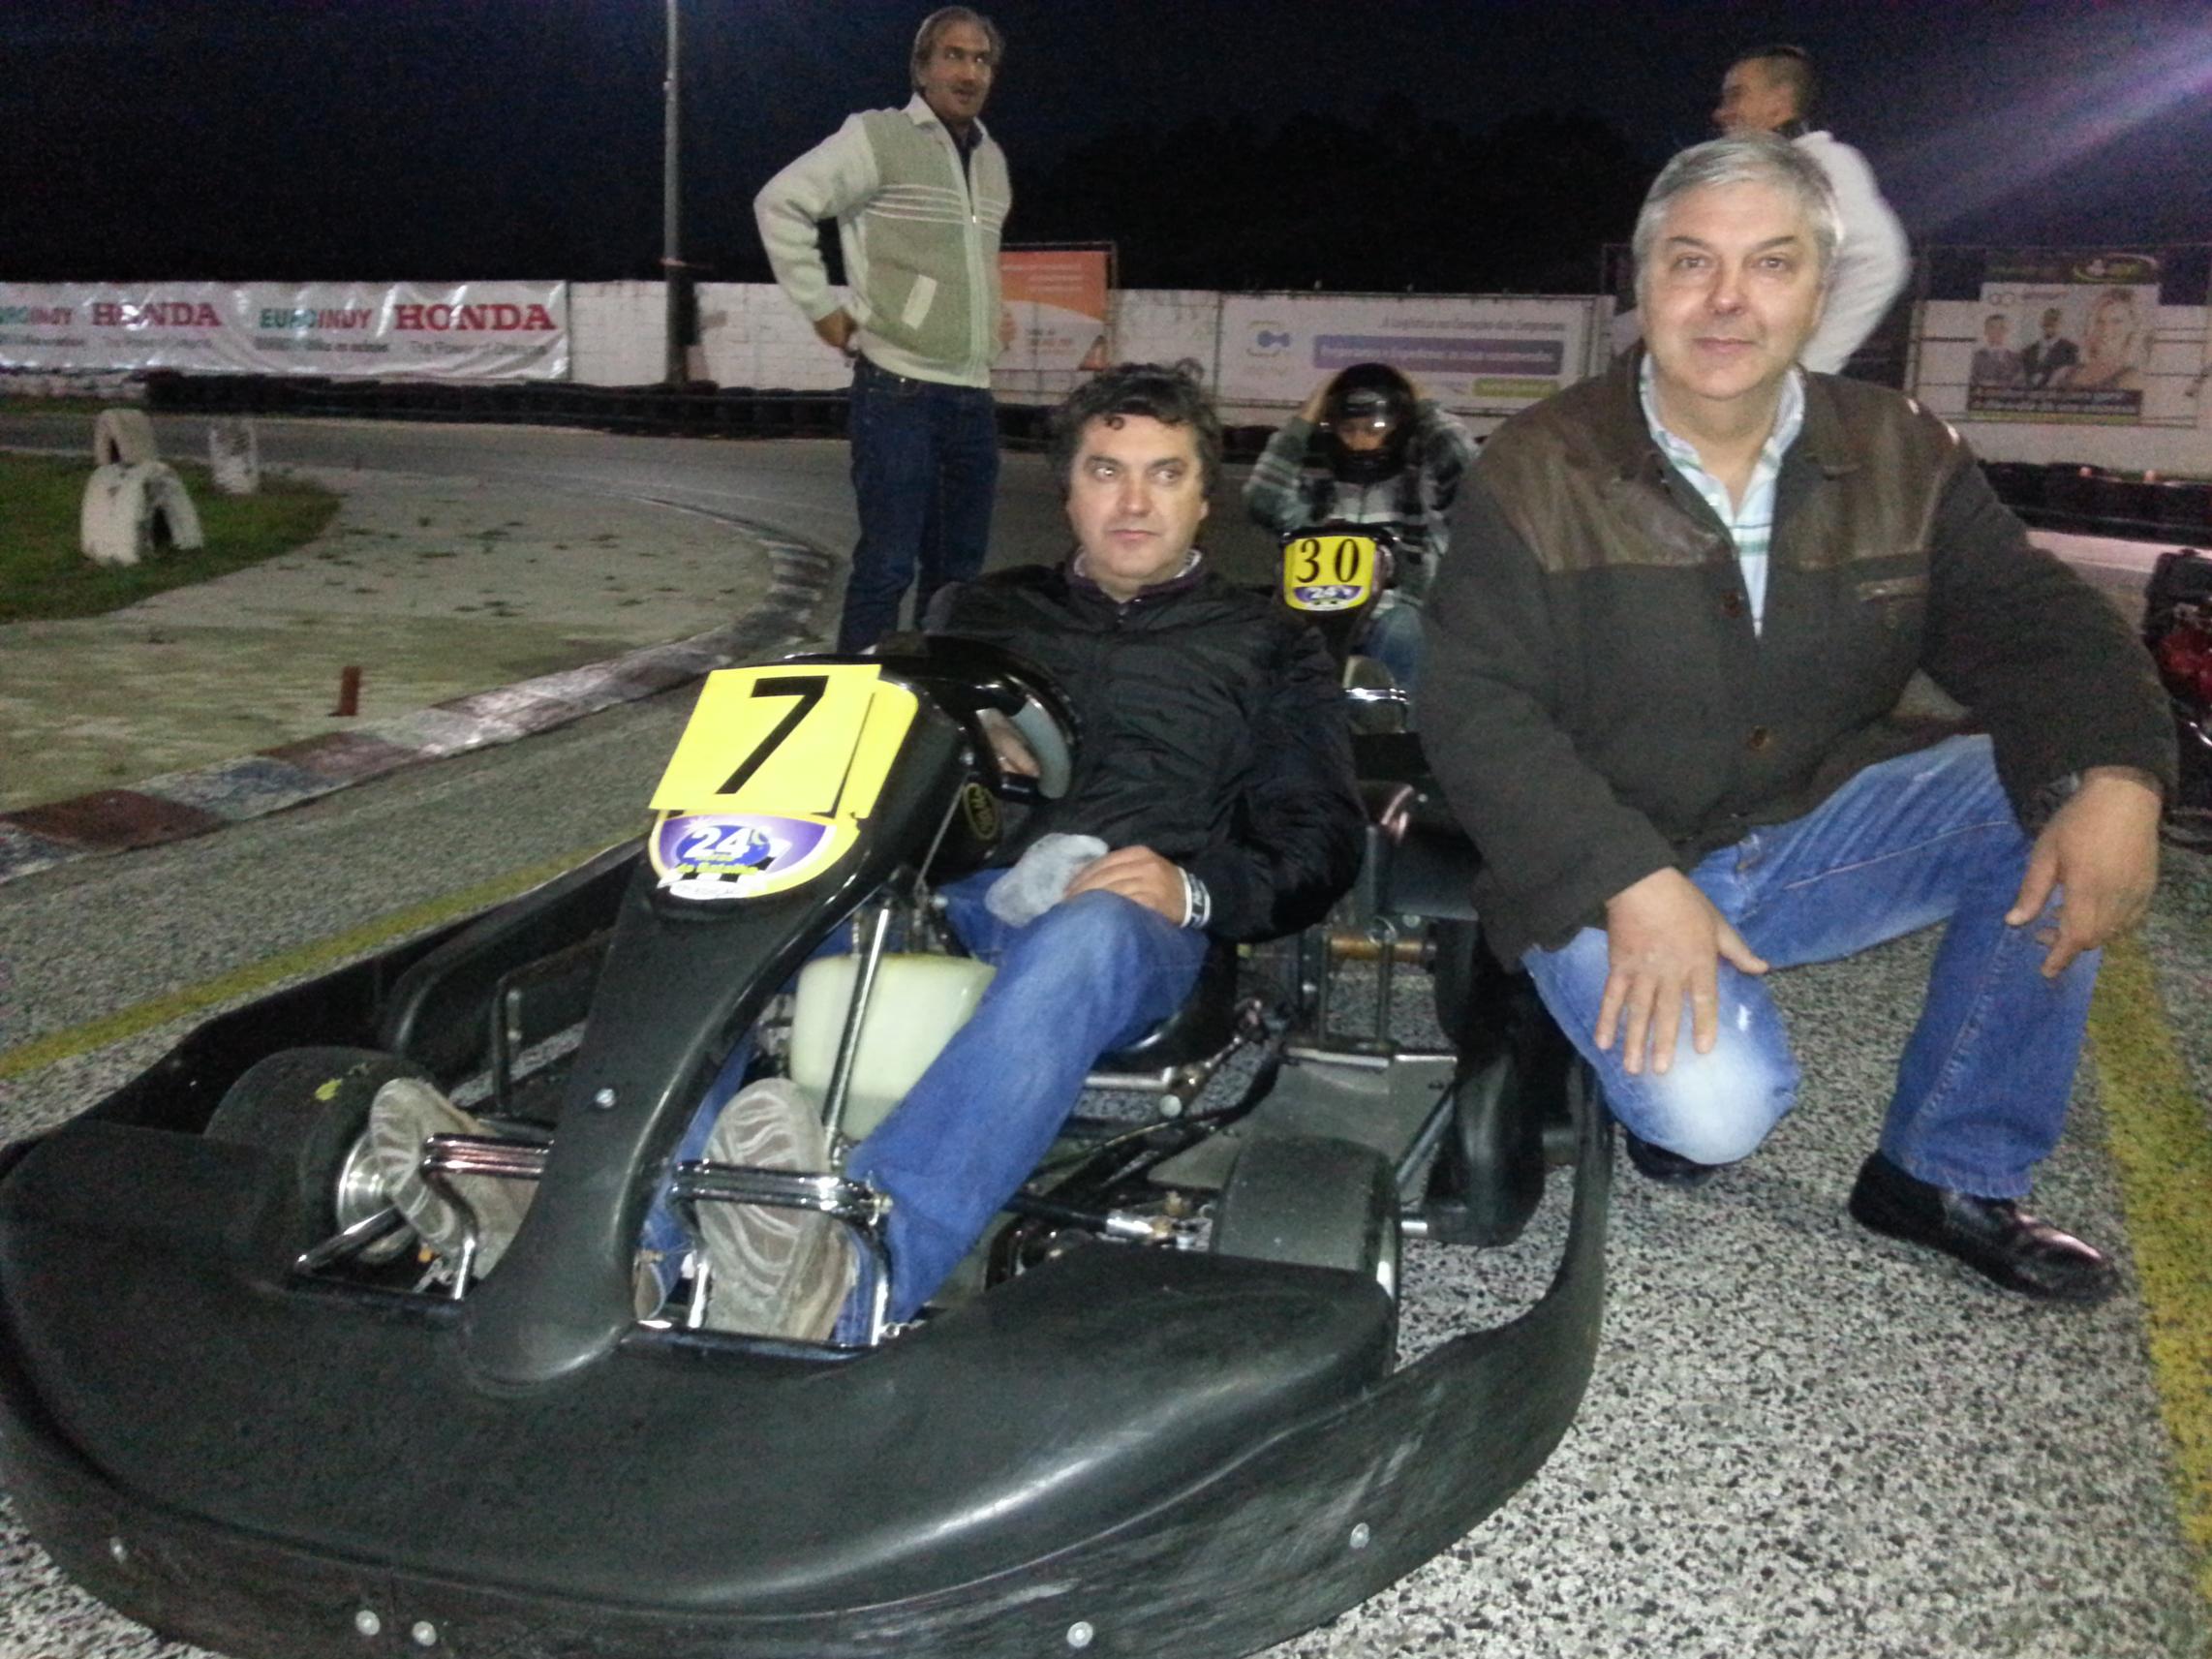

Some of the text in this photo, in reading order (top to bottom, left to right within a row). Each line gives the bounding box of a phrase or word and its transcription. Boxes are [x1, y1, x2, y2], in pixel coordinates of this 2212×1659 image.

[394, 303, 556, 331] HONDA
[1296, 538, 1361, 583] 30
[715, 675, 830, 795] 7
